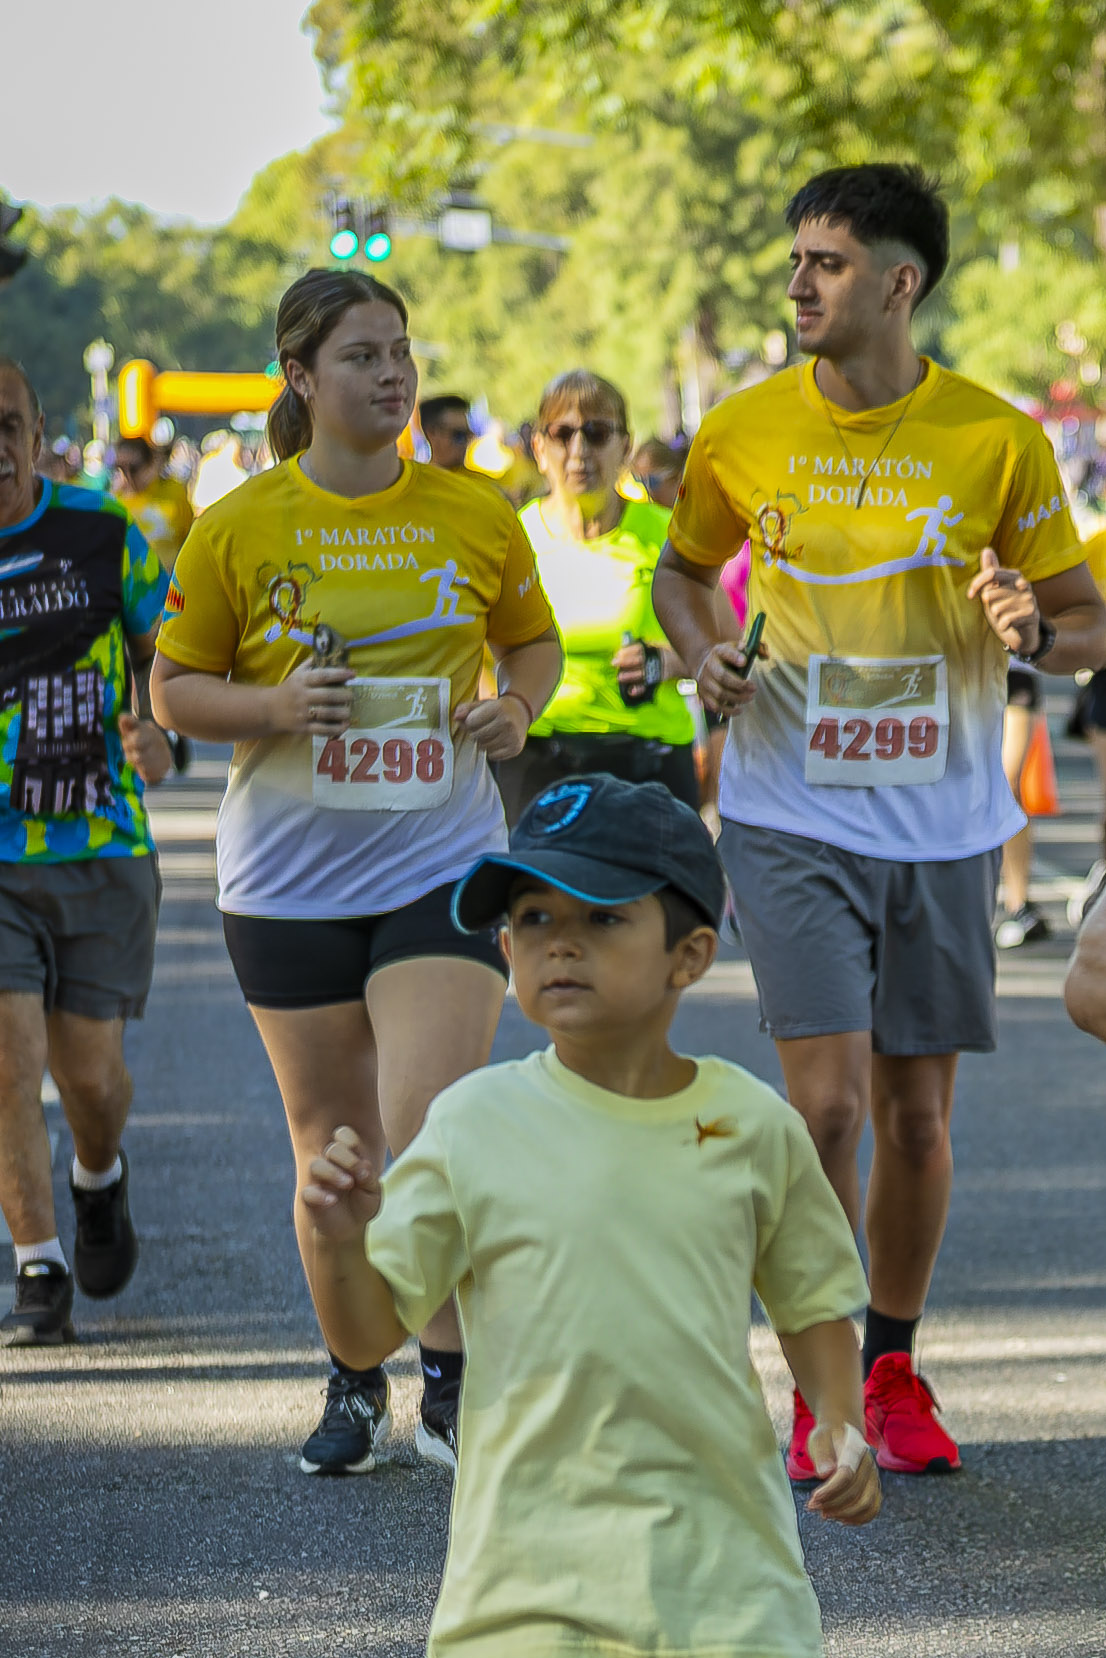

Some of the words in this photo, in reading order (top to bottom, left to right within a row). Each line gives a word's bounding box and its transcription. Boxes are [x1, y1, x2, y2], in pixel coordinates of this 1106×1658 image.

[813, 455, 933, 480] MARATÓN
[319, 521, 436, 546] MARATÓN
[319, 552, 419, 572] DORADA
[809, 715, 939, 761] 4299
[317, 737, 445, 785] 4298
